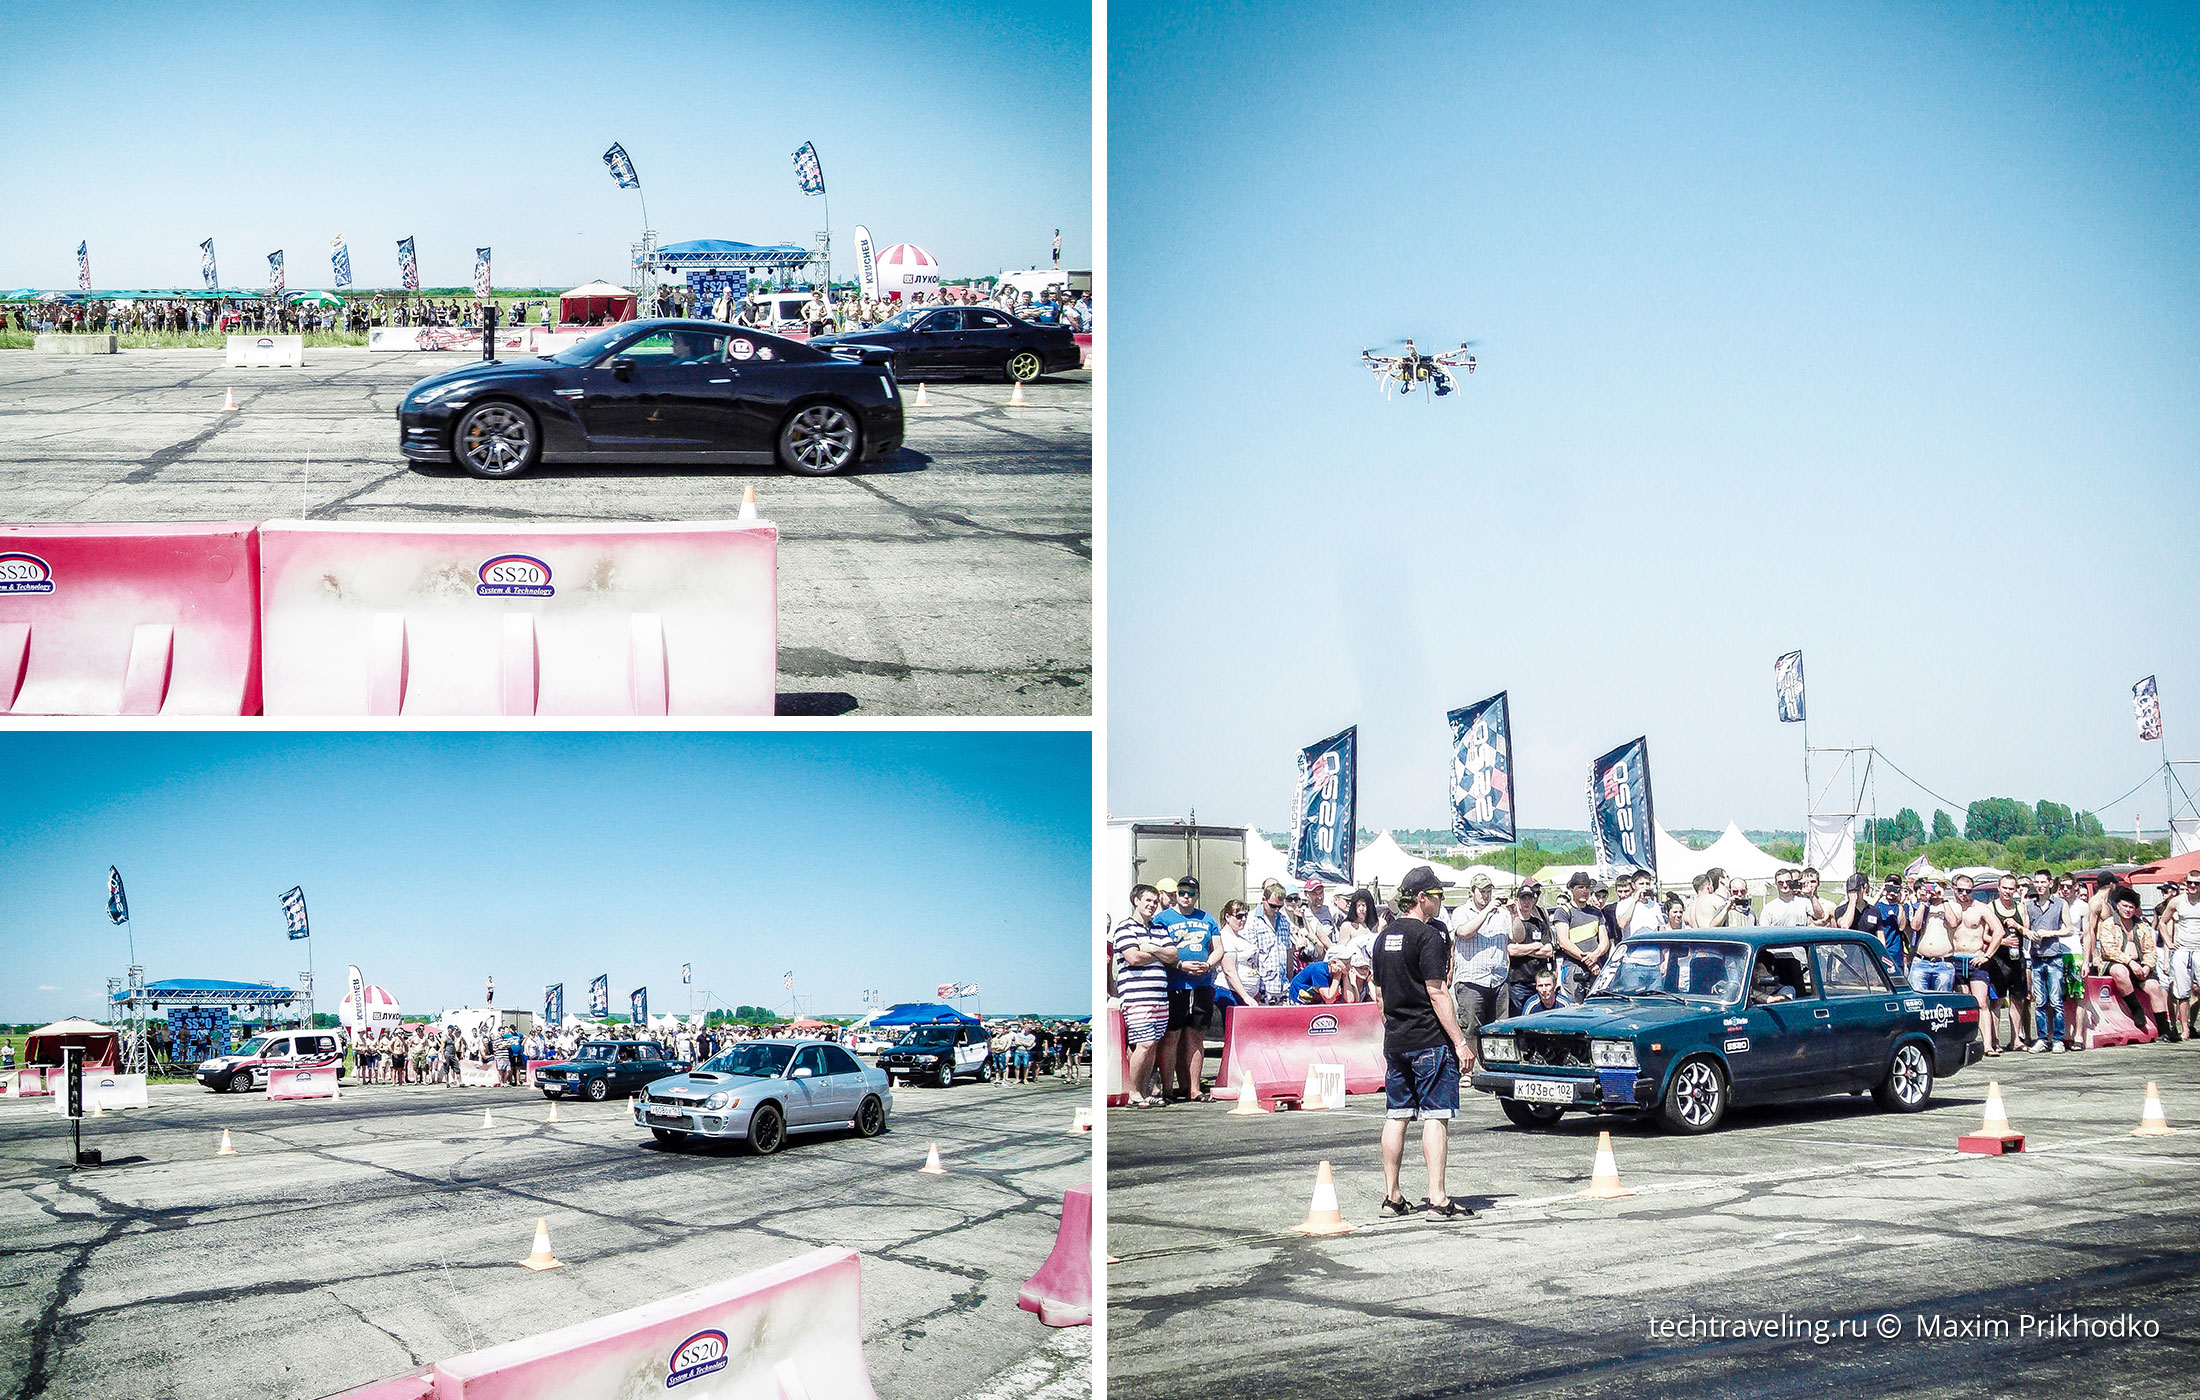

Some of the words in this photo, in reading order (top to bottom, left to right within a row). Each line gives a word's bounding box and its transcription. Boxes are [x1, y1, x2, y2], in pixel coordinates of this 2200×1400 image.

[493, 566, 539, 583] SS20
[479, 586, 504, 595] System
[505, 586, 511, 594] &
[513, 586, 552, 596] Technology
[1316, 1072, 1341, 1097] ТАРТ
[681, 1340, 718, 1367] SS20
